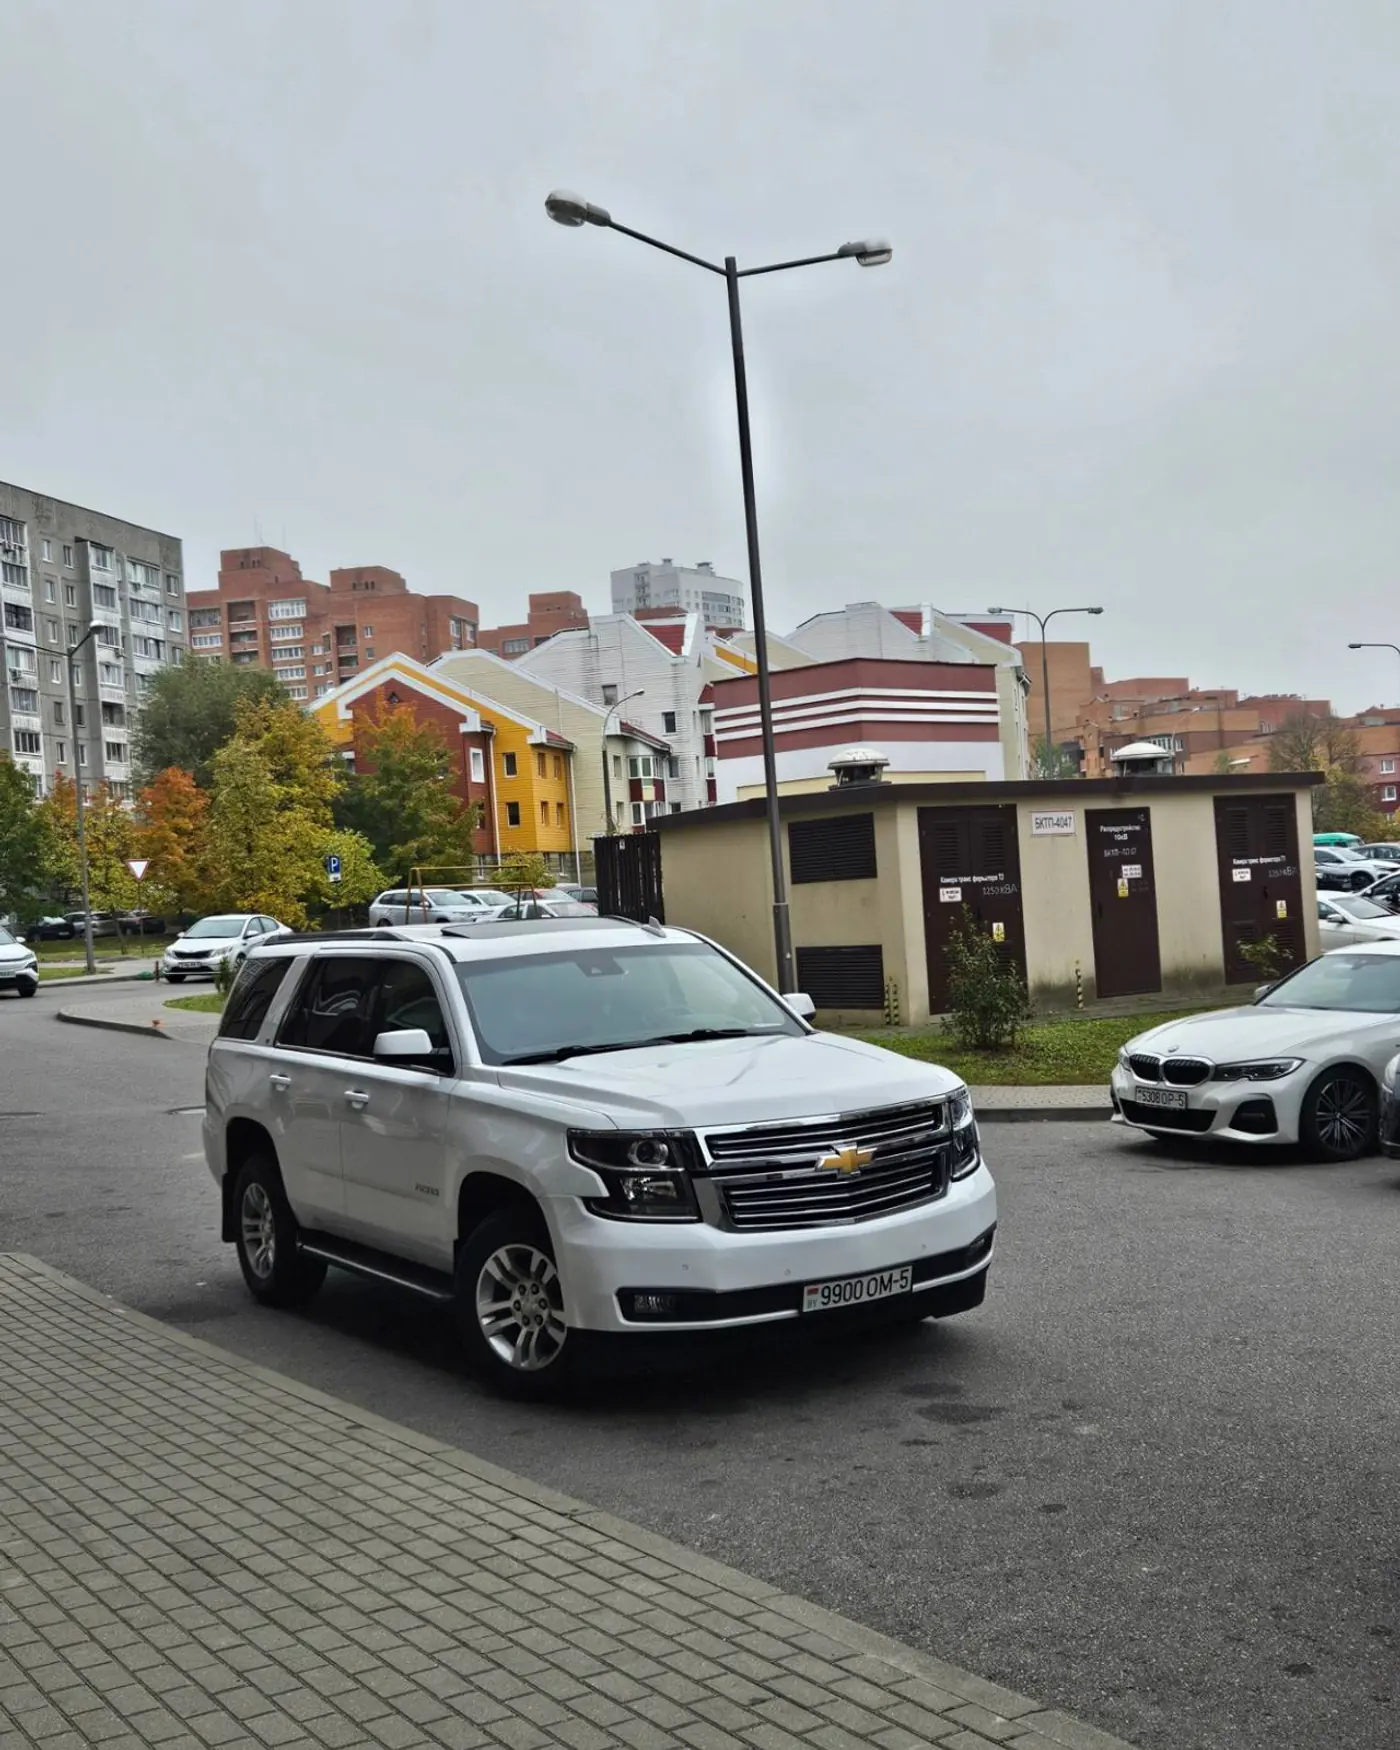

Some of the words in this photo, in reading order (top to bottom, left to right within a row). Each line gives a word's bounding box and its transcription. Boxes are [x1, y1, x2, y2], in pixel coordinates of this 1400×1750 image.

[1035, 816, 1072, 829] БКТП-4047
[331, 857, 338, 871] P
[821, 1280, 863, 1306] 9900
[866, 1268, 909, 1297] OM-5
